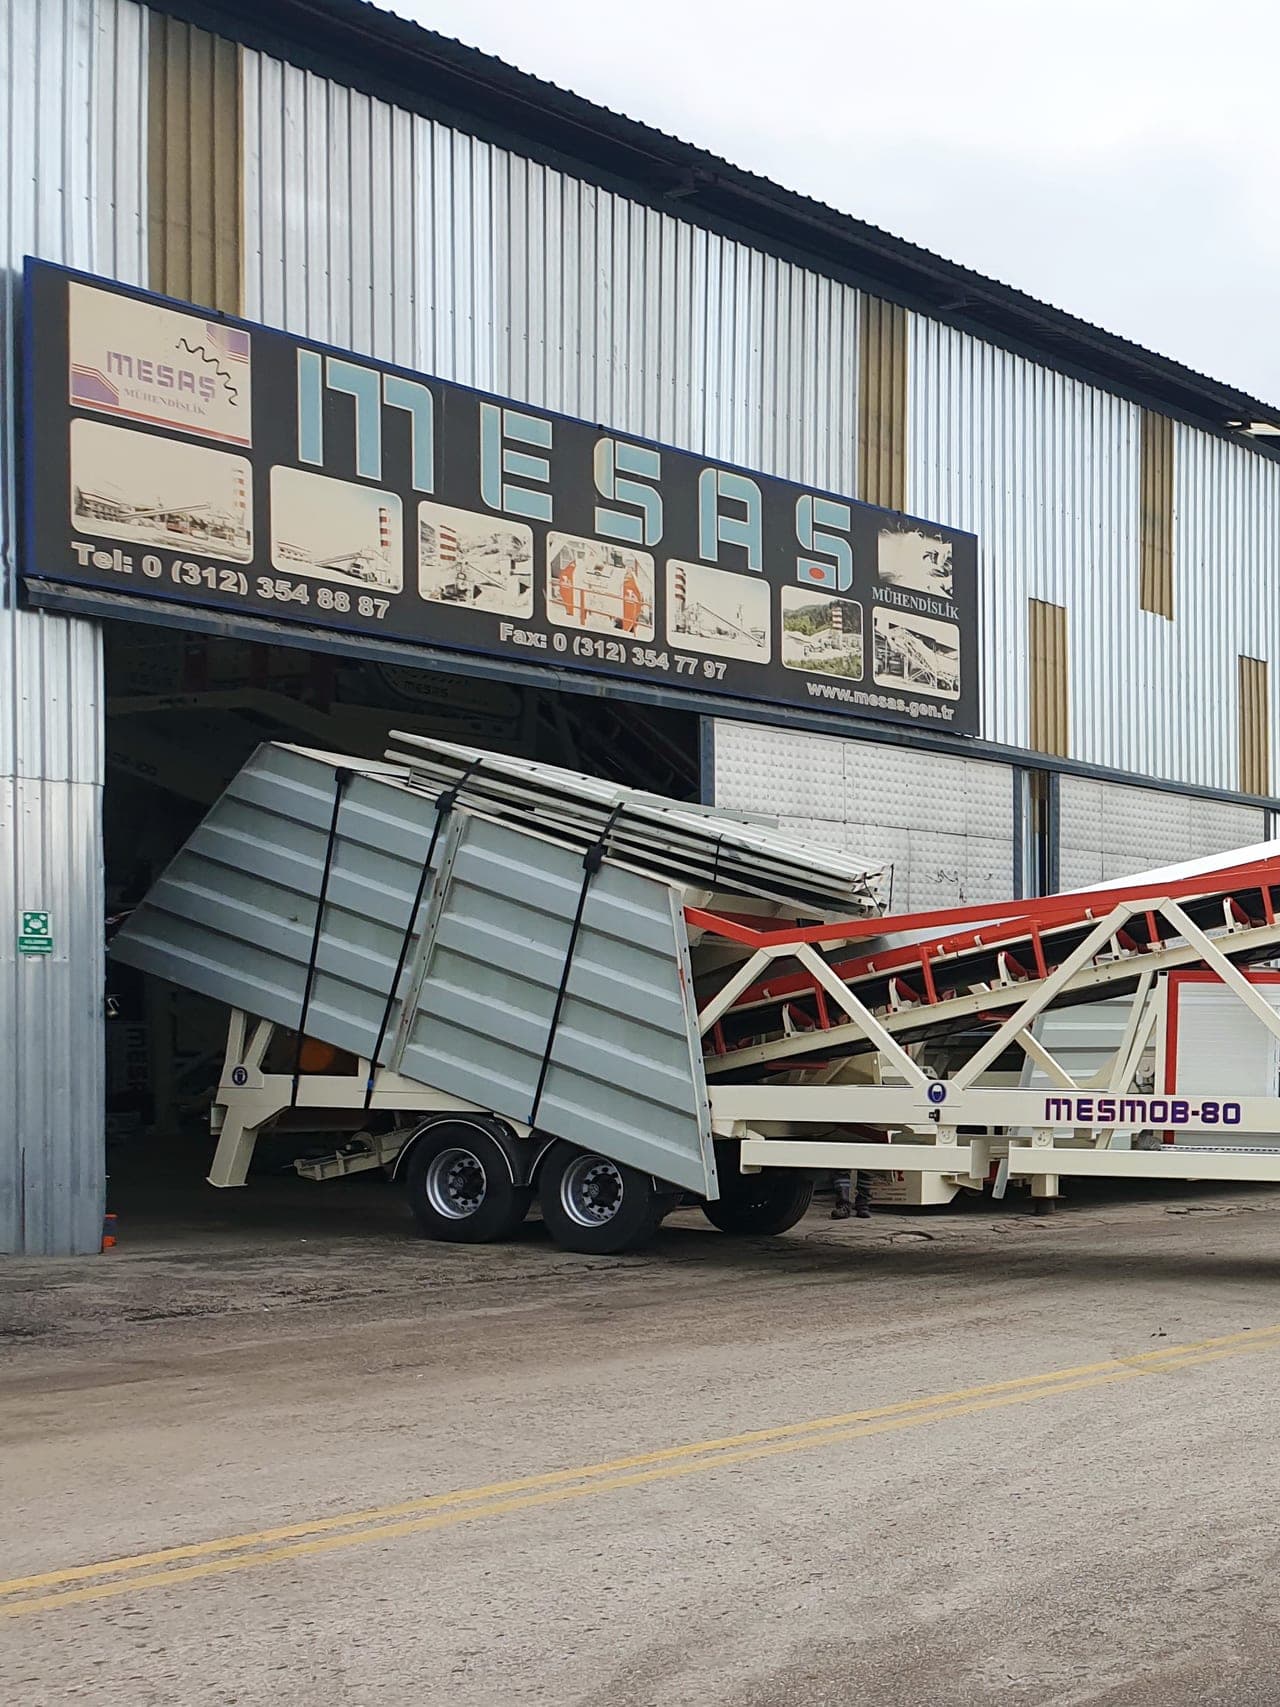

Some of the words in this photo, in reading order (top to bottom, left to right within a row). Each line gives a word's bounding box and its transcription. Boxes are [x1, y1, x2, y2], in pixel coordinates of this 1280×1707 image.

[70, 541, 133, 574] Tel:
[142, 554, 162, 578] 0
[171, 560, 248, 596] (312)
[256, 576, 310, 605] 354
[317, 587, 351, 613] 88
[358, 596, 390, 620] 87
[872, 586, 960, 621] MÜHENDİSLİK
[499, 622, 548, 649] Fax:
[553, 632, 568, 652] 0
[573, 635, 627, 664] (312)
[631, 646, 670, 671] 354
[674, 655, 698, 675] 77
[703, 660, 728, 680] 97
[806, 682, 955, 721] www.mesas.gen.tr
[1045, 1097, 1241, 1125] MESMOB-80
